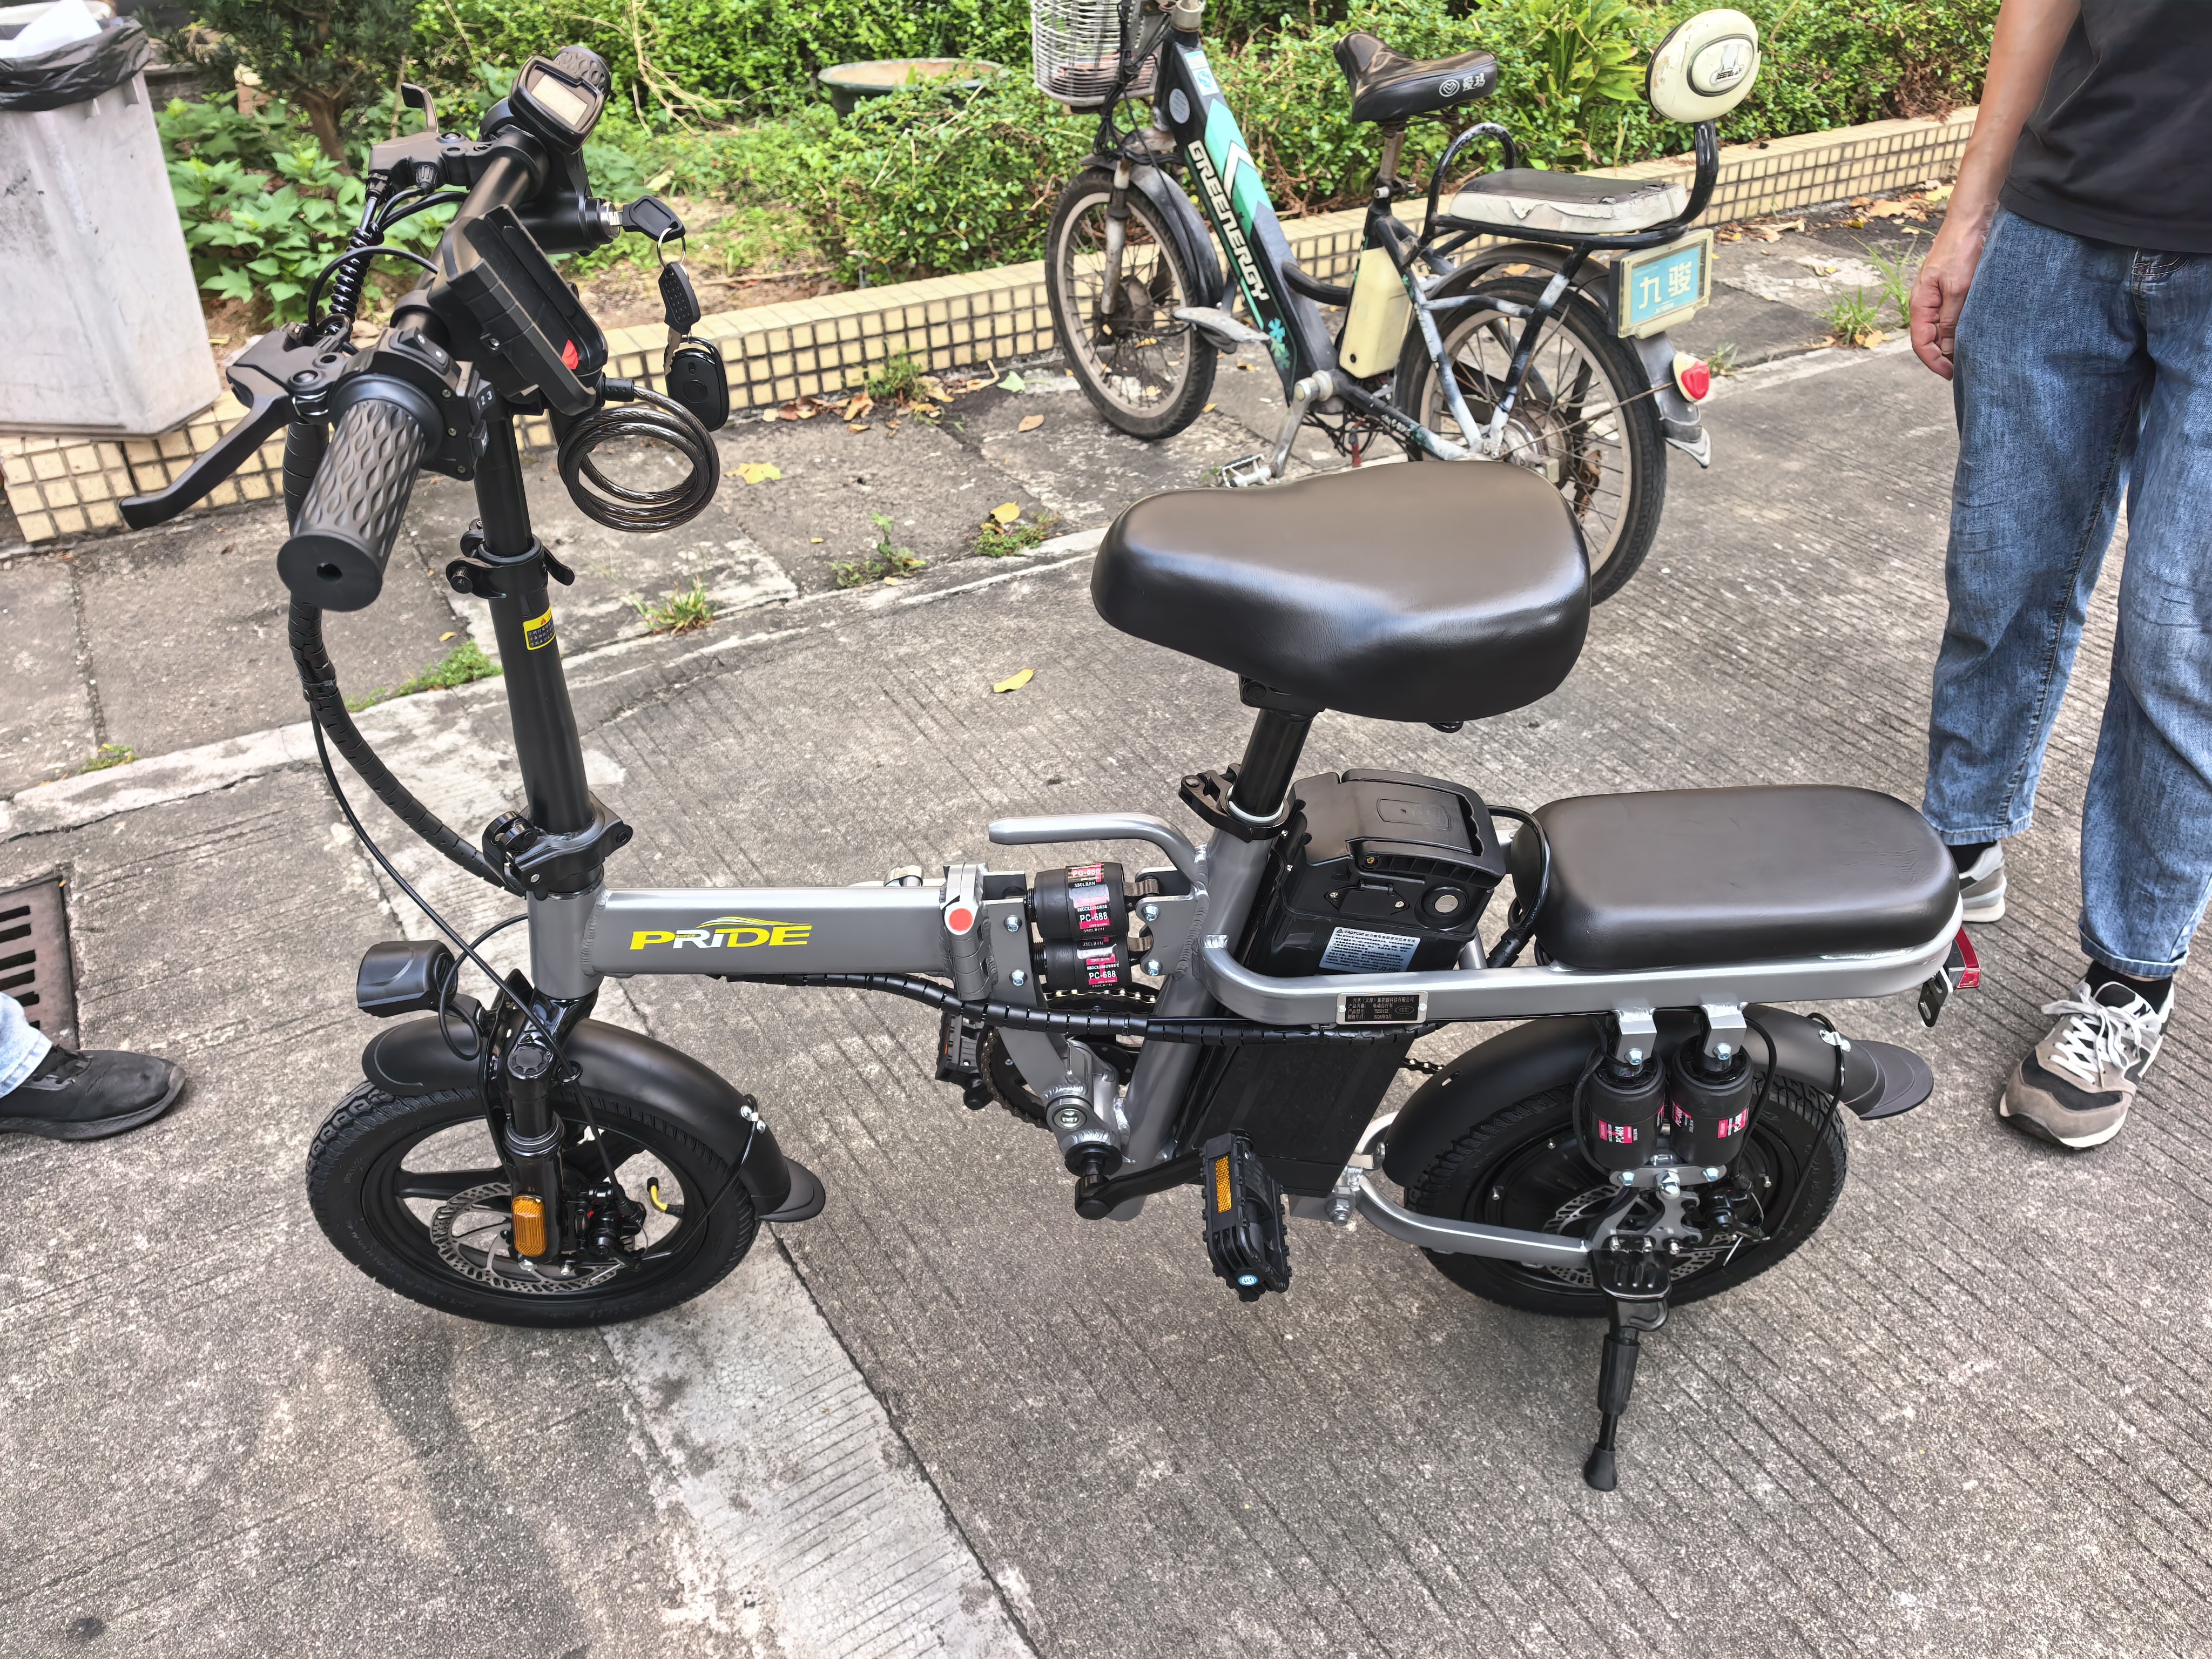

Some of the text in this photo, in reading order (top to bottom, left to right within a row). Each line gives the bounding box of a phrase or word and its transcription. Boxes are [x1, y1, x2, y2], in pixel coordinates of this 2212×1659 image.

[1188, 139, 1270, 301] GREENERGY
[1639, 261, 1692, 309] 九骏
[487, 390, 493, 400] 3
[1080, 912, 1108, 923] PC-688
[630, 925, 812, 950] PRIDE
[1089, 970, 1116, 980] PC-688
